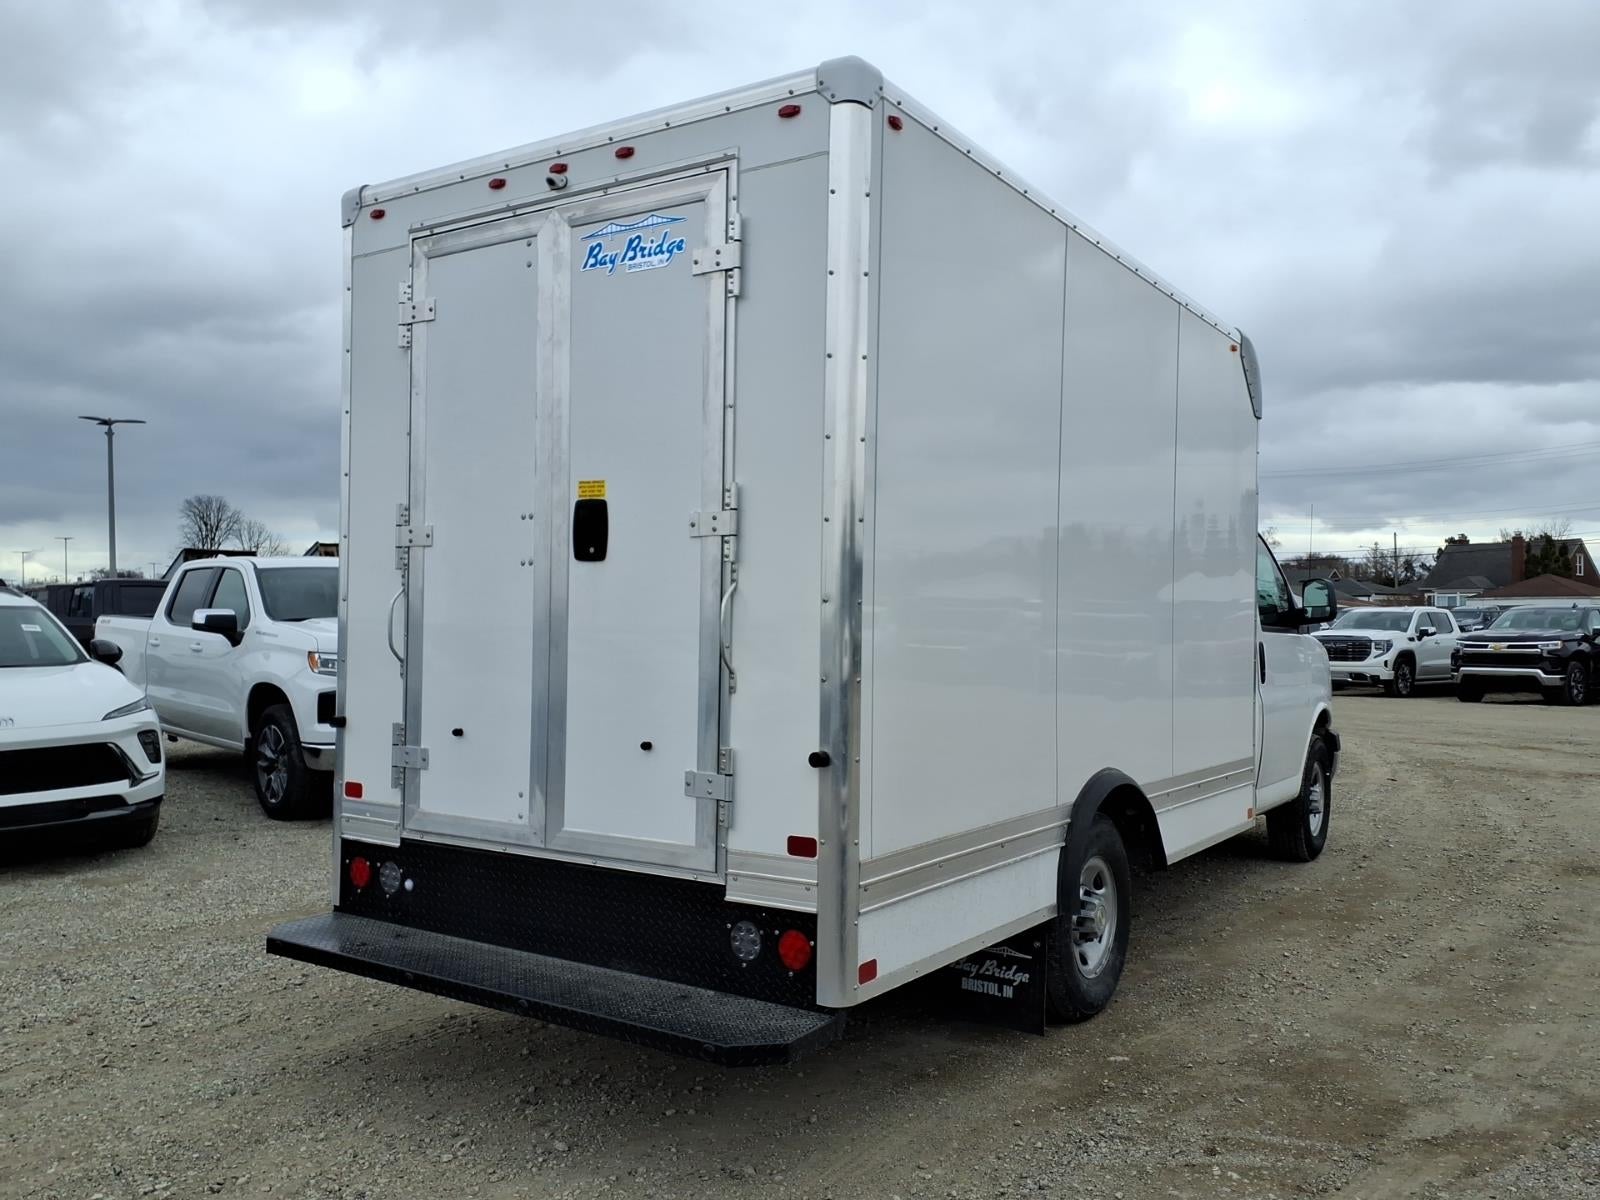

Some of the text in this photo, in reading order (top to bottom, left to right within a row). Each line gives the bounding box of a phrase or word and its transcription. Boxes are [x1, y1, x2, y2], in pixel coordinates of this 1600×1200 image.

[582, 230, 686, 274] Bay Bridge
[979, 959, 1030, 986] Bridge
[1002, 984, 1013, 999] IN
